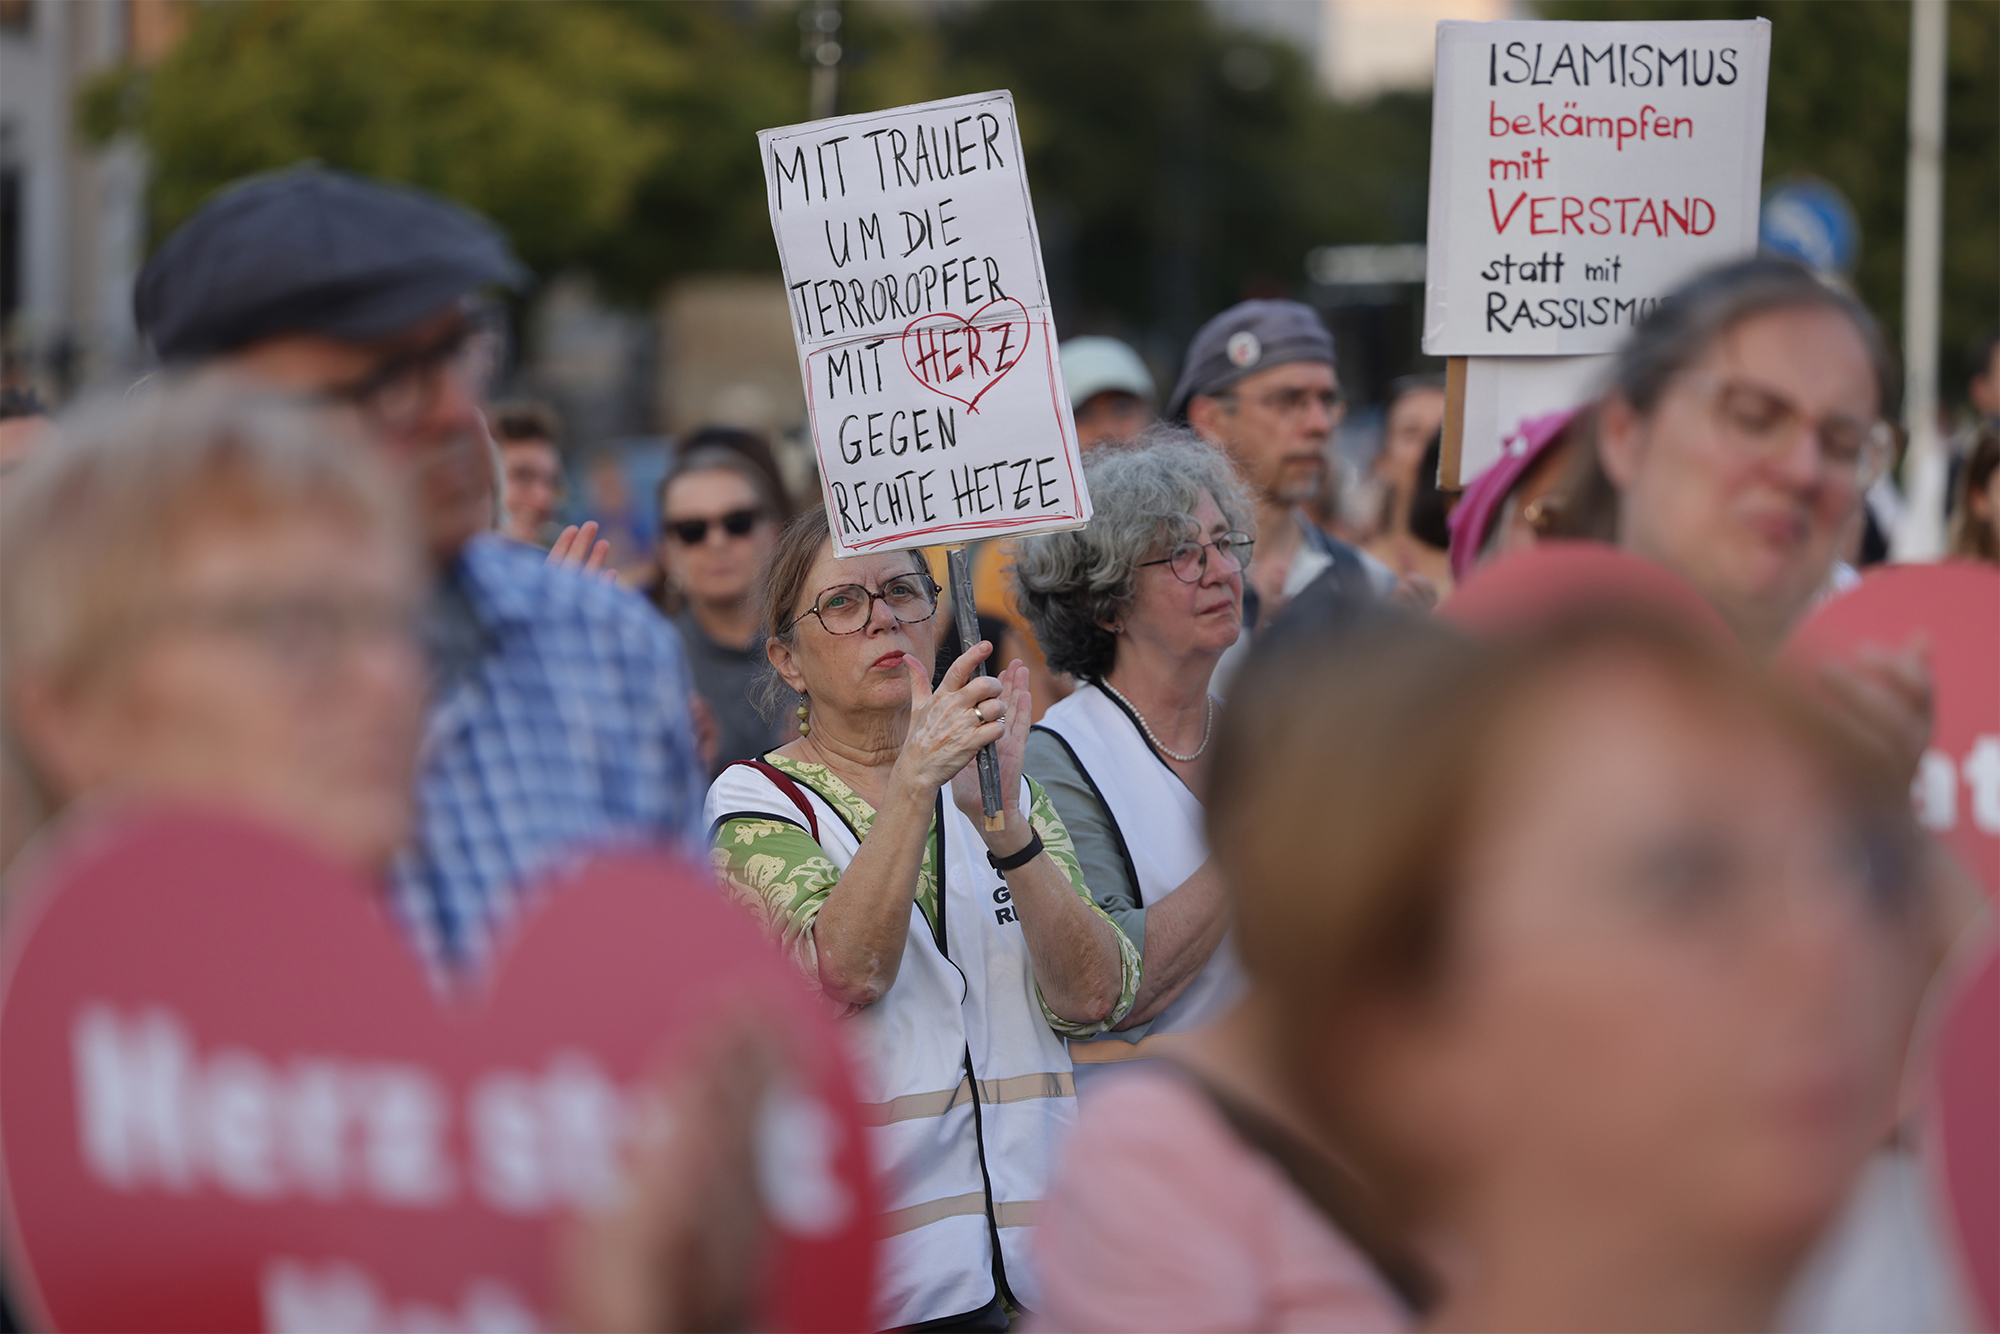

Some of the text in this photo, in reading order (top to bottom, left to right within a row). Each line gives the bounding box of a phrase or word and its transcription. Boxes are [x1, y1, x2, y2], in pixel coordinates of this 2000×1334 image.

[1488, 41, 1739, 87] ISLAMISMUS
[1489, 100, 1694, 151] bekämpfen
[772, 112, 1005, 211] MIT TRAUER
[1489, 147, 1550, 180] mit
[825, 198, 962, 268] UM DIE
[1488, 187, 1717, 237] VERSTAND
[1481, 252, 1622, 285] statt mit
[790, 256, 1009, 339] TERROROPFER
[1486, 292, 1668, 333] RASSISMU
[826, 322, 1014, 400] MIT HERZ
[838, 406, 957, 465] GEGEN
[831, 456, 1061, 535] RECHTE HETZE
